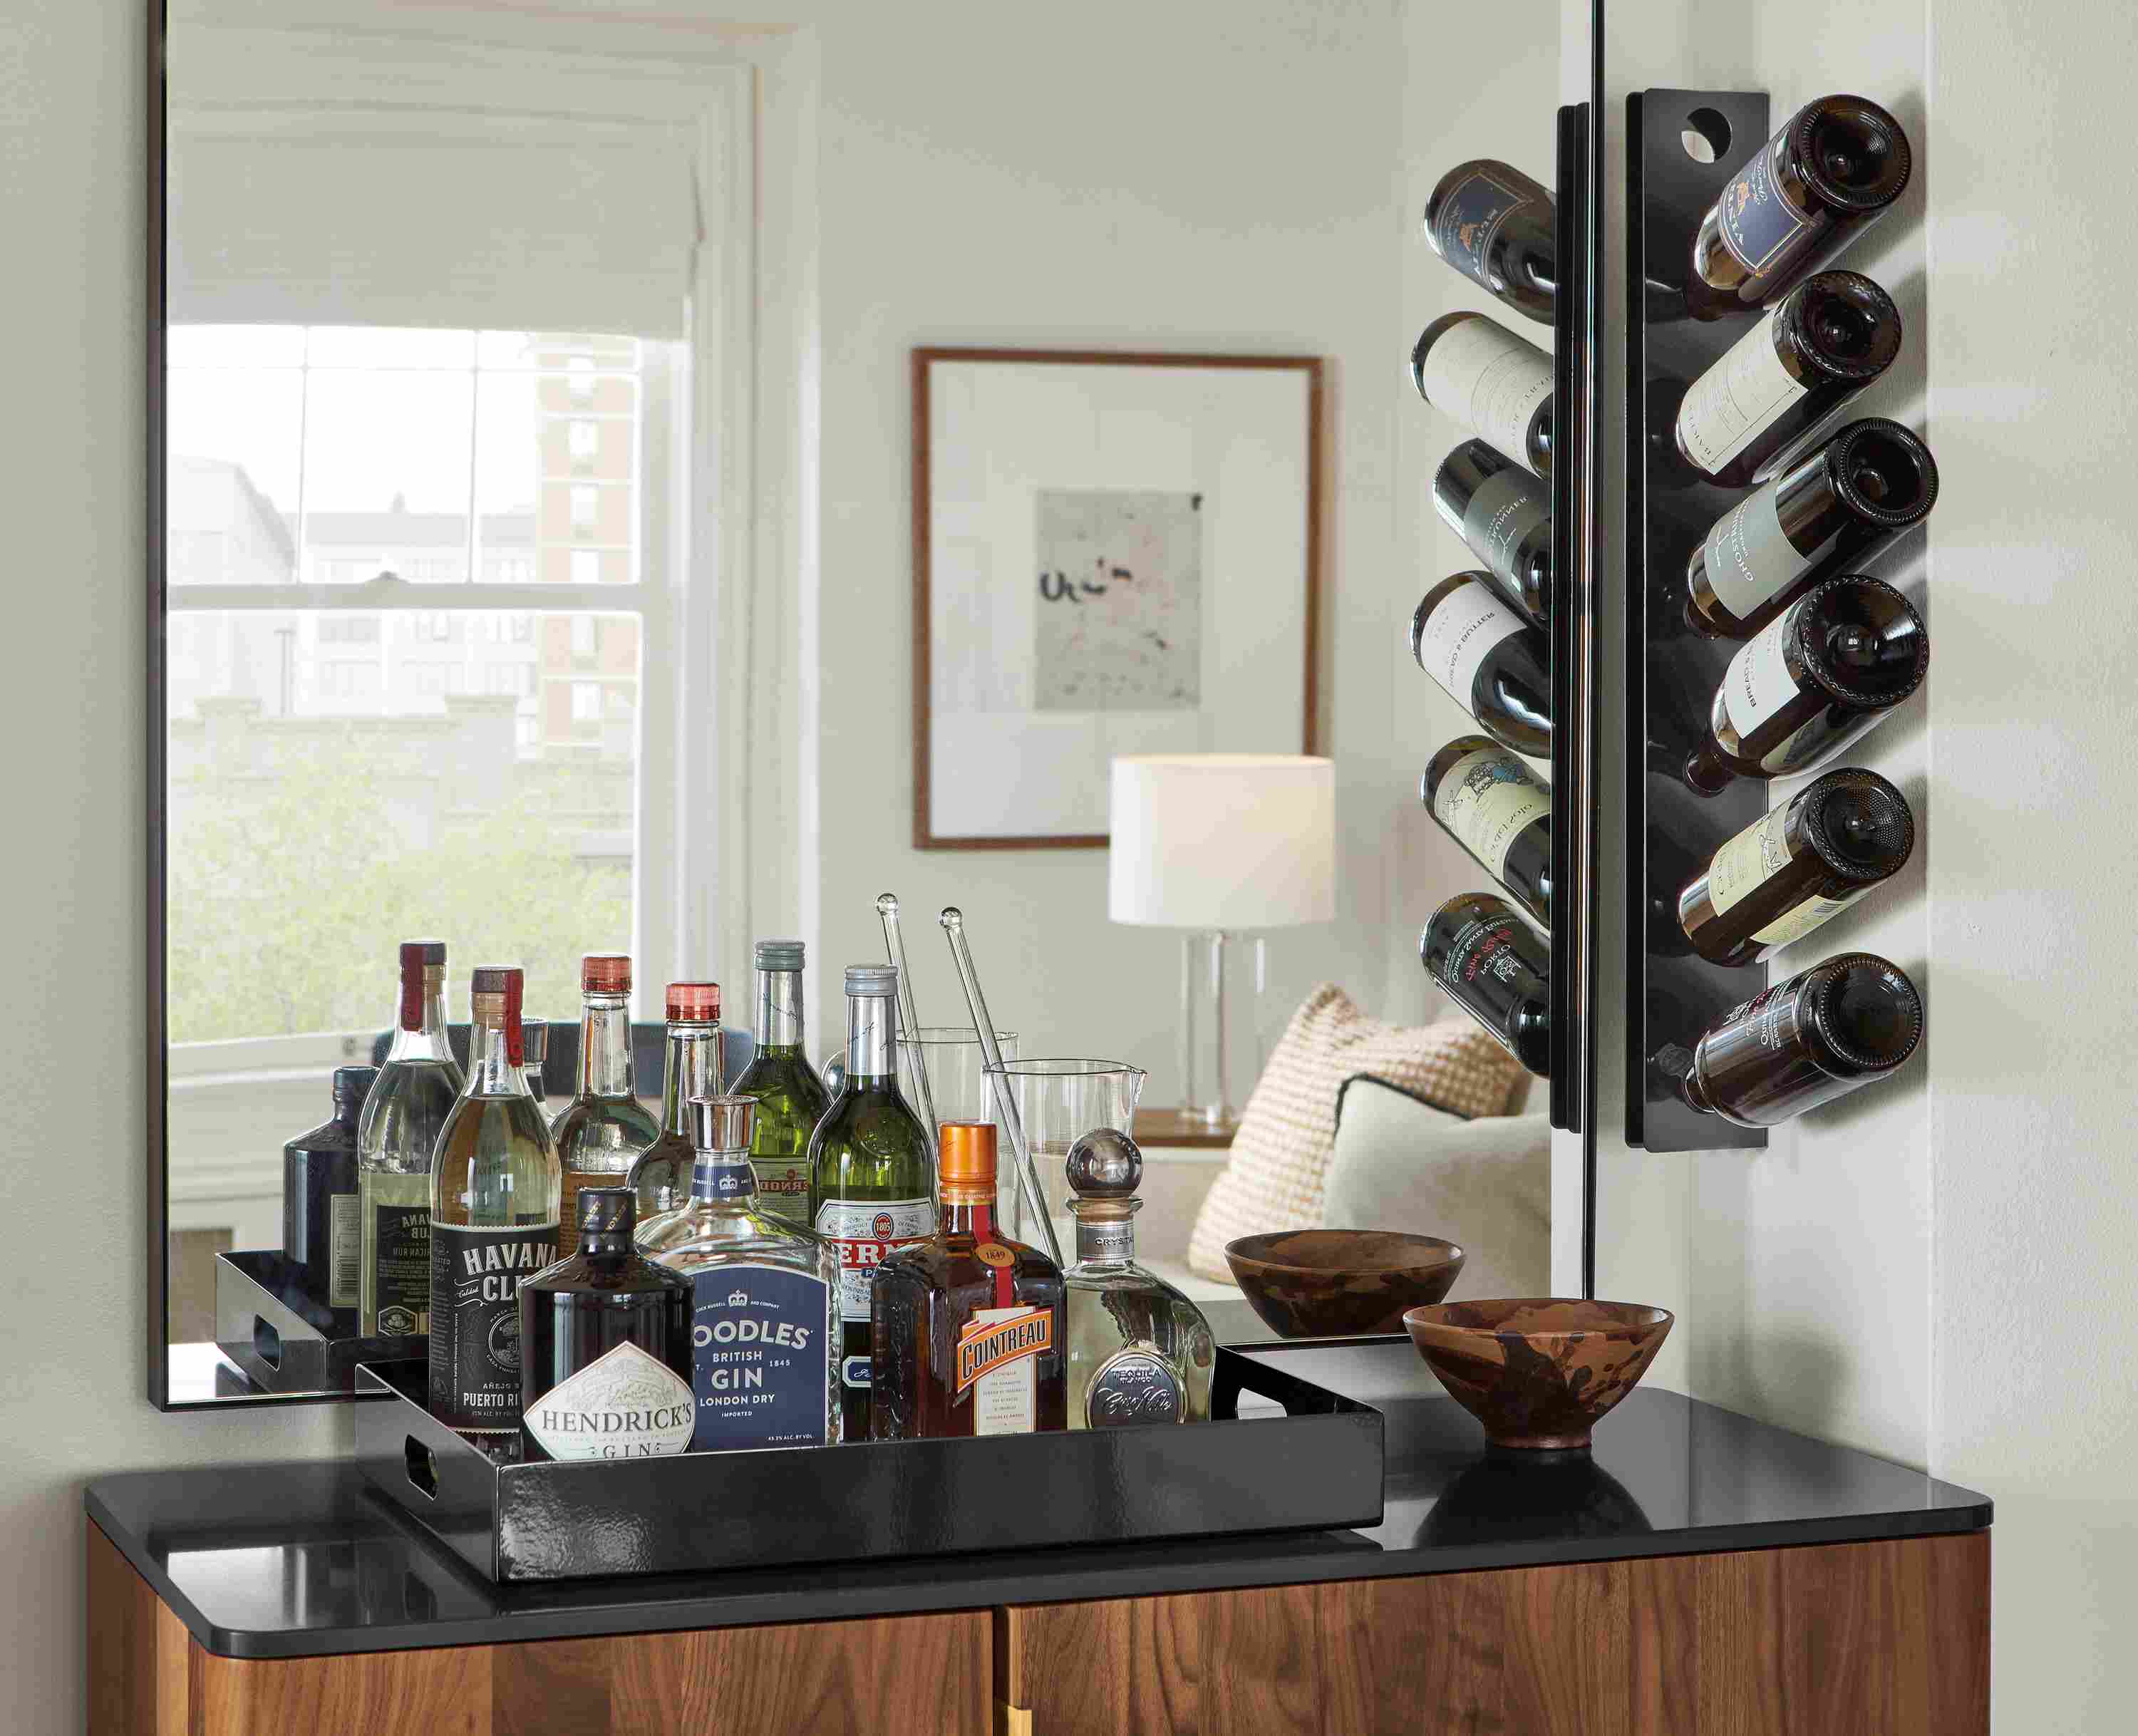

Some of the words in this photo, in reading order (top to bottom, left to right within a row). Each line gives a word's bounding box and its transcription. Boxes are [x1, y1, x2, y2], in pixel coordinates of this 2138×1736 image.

[876, 1222, 890, 1231] 1805
[1095, 1236, 1135, 1246] CRYSTA
[463, 1243, 559, 1276] HAVANA
[986, 1251, 1005, 1260] 1849
[760, 1300, 780, 1311] COMPANY
[694, 1319, 810, 1350] OODLES
[962, 1318, 1048, 1380] COINTREAU
[713, 1350, 763, 1363] BRITISH
[769, 1359, 791, 1368] 1845
[711, 1367, 763, 1390] GIN
[1110, 1368, 1162, 1380] TEQUILA
[463, 1392, 504, 1407] PUERTO
[507, 1393, 518, 1407] RI
[700, 1395, 748, 1407] LONDON
[753, 1393, 775, 1404] DRY
[542, 1402, 692, 1432] HENDRICK'S
[603, 1442, 651, 1459] GIN
